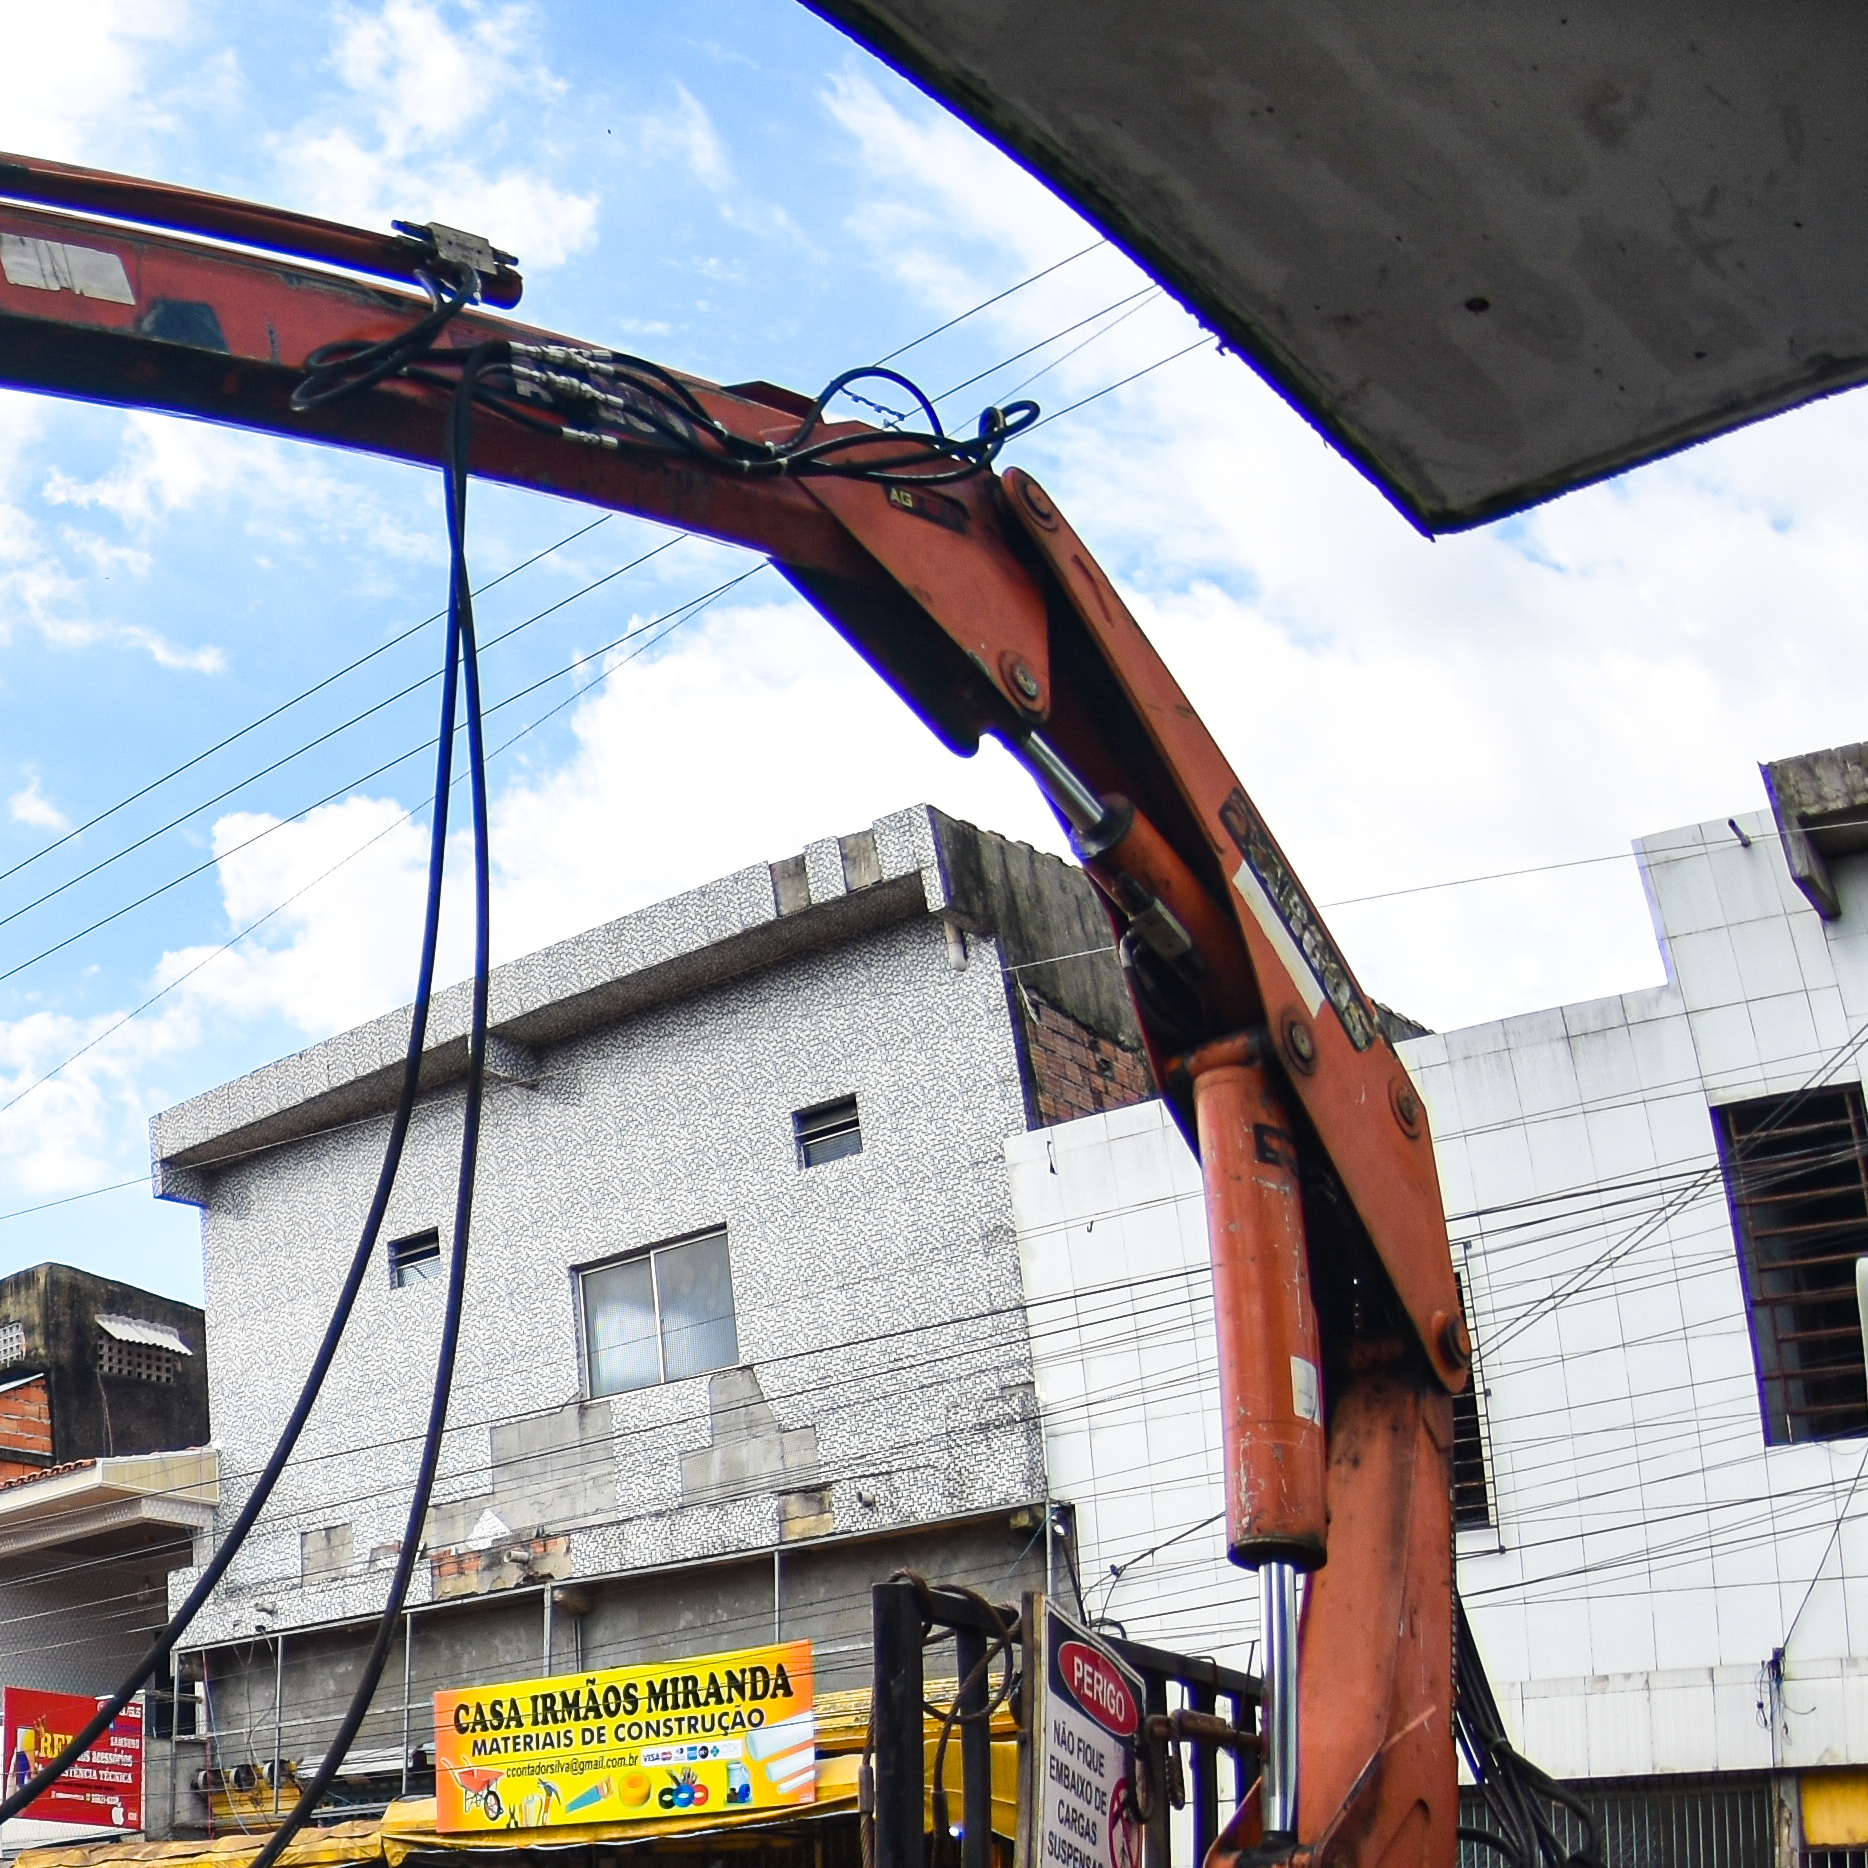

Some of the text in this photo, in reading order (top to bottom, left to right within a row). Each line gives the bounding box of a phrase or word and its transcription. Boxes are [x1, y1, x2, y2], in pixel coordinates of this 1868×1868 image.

[453, 1662, 794, 1736] CASA IRMÃOS MIRANDA
[1073, 1654, 1126, 1723] PERIGO
[471, 1705, 766, 1758] MATERIAIS DE CONSTRUÇÃO
[643, 1753, 661, 1763] VISA
[1053, 1718, 1106, 1779] NÃO FIQUE
[98, 1767, 133, 1784] TÉCNICA
[506, 1752, 640, 1779] ccontadorsilva@gmail.com.br
[1049, 1753, 1108, 1817] EMBAIXO DE
[1057, 1797, 1098, 1847] CARGAS
